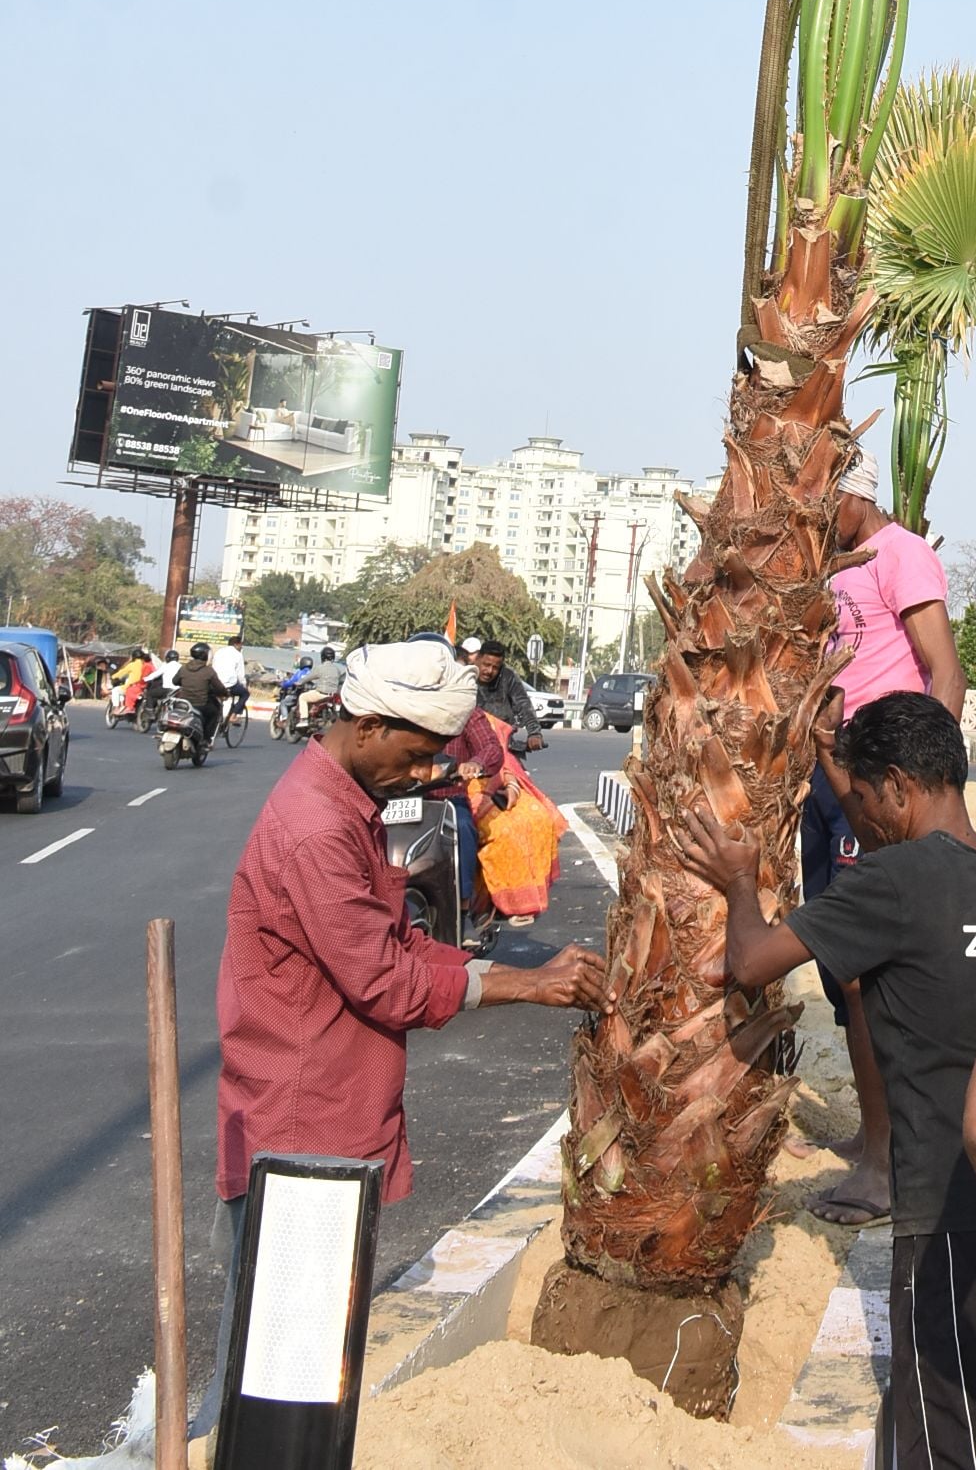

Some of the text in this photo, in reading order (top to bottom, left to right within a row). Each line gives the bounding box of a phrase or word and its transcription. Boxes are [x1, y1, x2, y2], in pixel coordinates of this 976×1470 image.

[124, 375, 213, 397] 80% green landscape
[146, 370, 192, 384] panoramic
[192, 377, 216, 388] views
[120, 405, 229, 429] #OneFloorOneApartment
